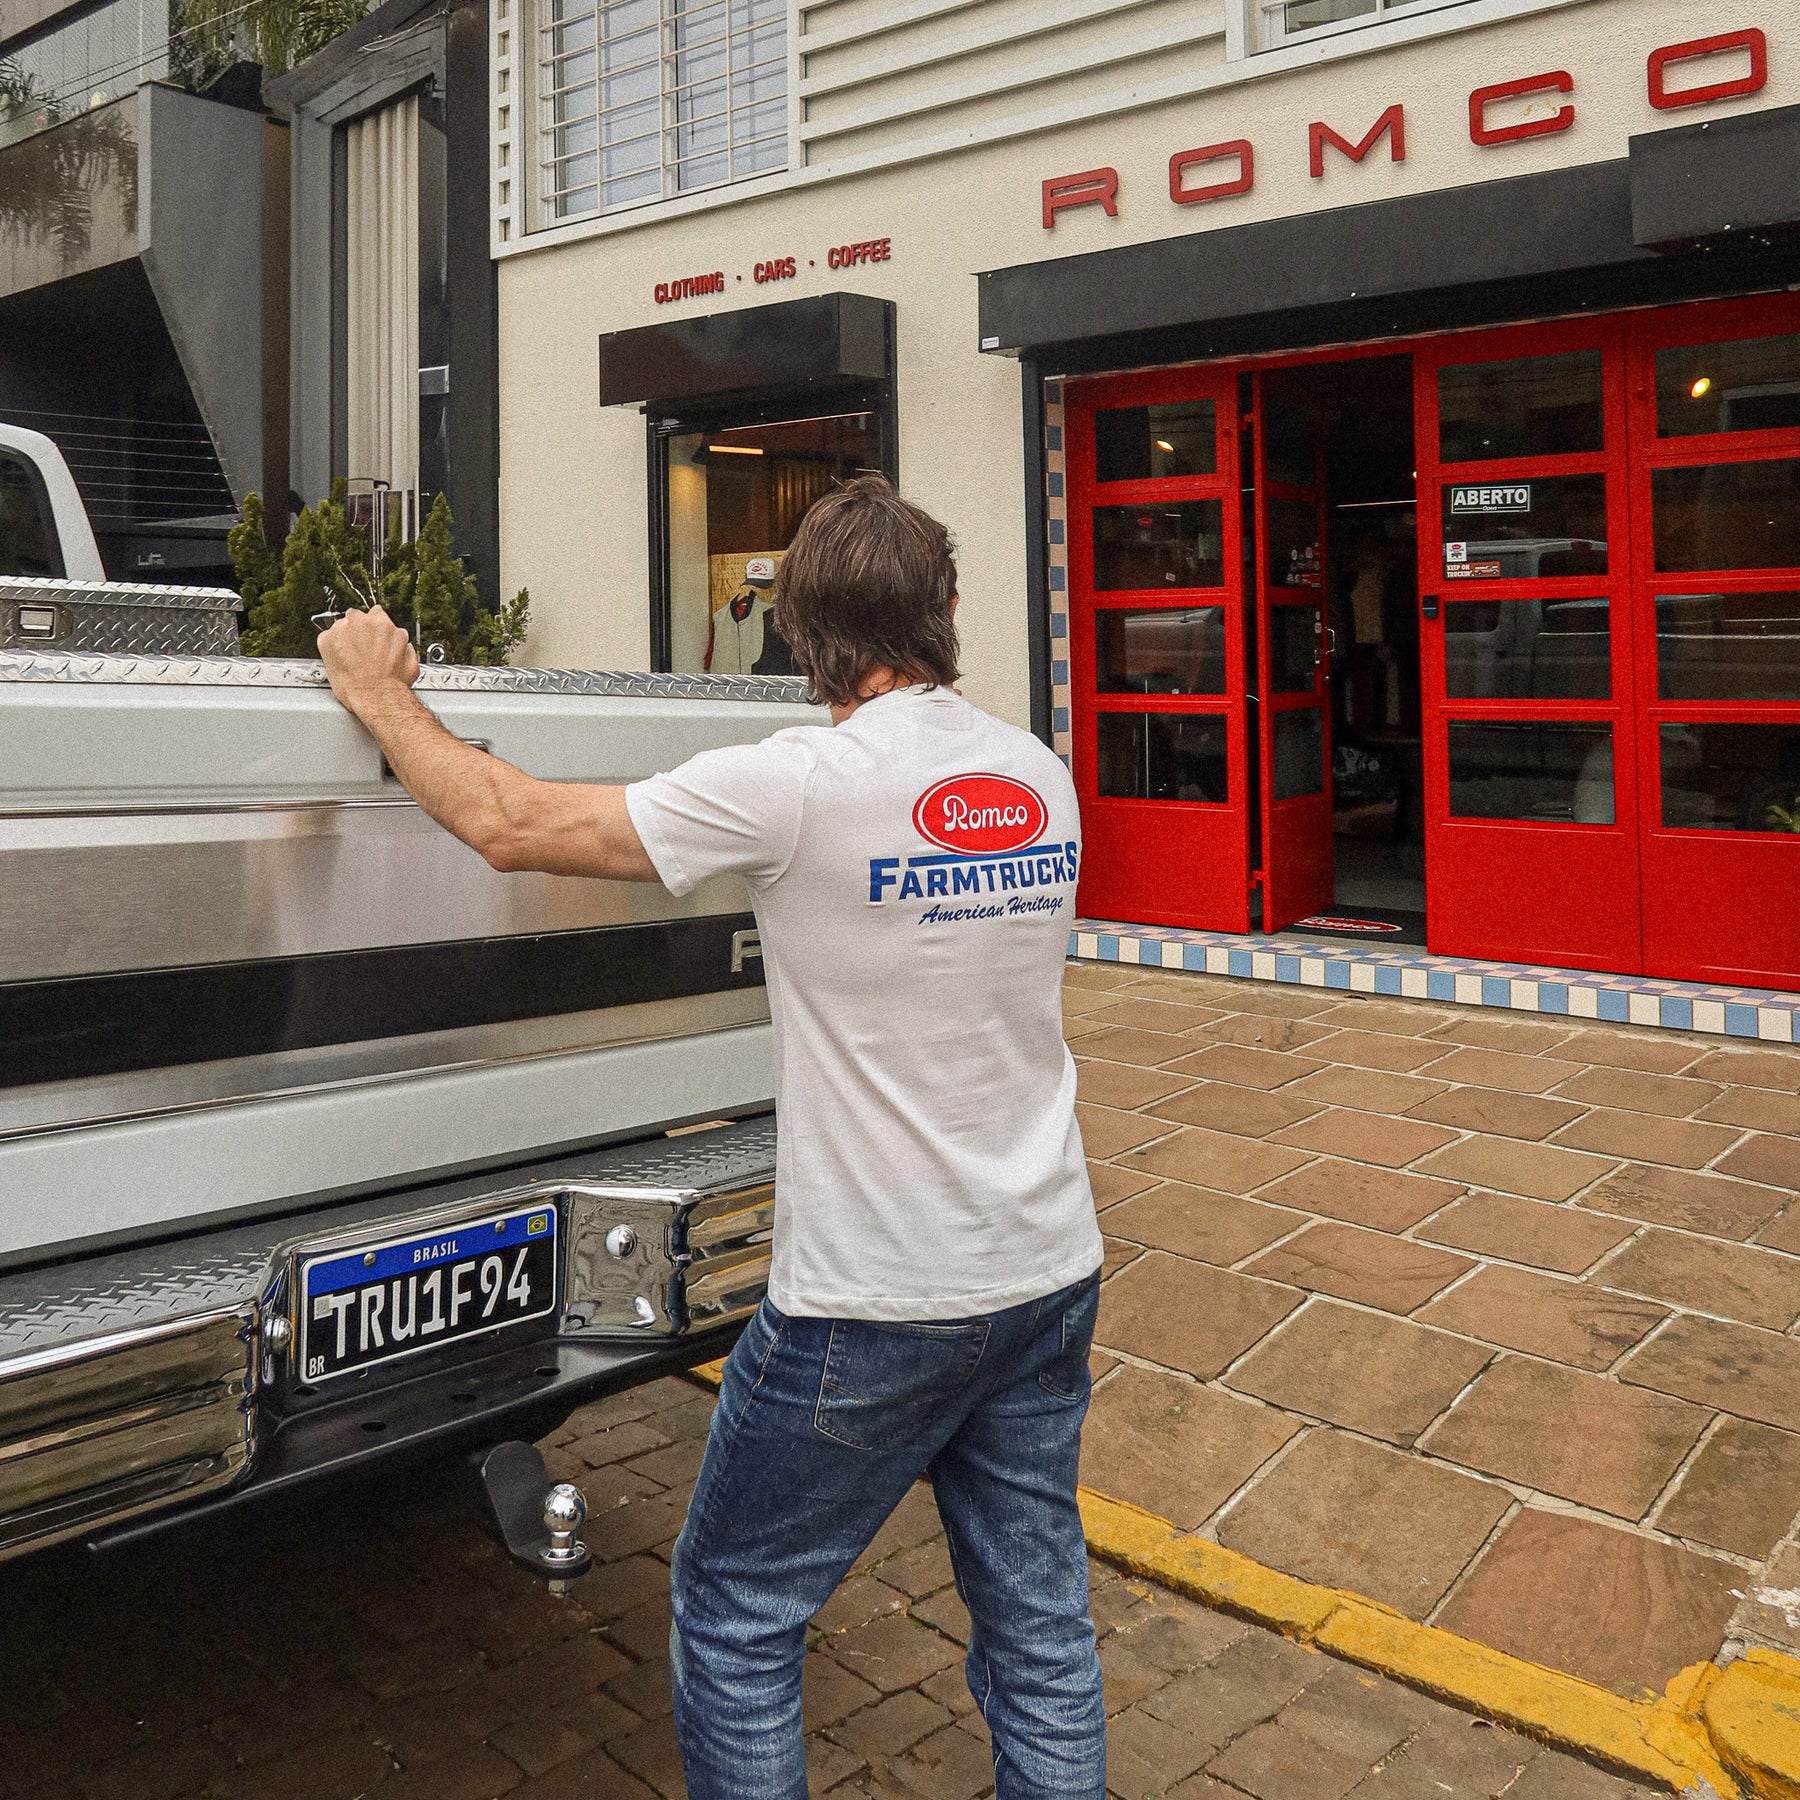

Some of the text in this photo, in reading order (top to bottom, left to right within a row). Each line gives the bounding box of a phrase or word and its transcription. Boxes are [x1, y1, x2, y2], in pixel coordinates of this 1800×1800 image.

[1042, 28, 1767, 229] ROMCO
[654, 237, 891, 303] CLOTHING CARS COFFEE
[1454, 488, 1528, 506] ABERTO
[1482, 505, 1498, 513] Open
[942, 794, 1028, 832] Romco
[869, 841, 1078, 902] FARMTRUCKS
[918, 896, 1064, 925] American Heritage
[413, 1240, 459, 1264] BRASIL
[328, 1247, 532, 1359] TRU1F94
[309, 1355, 325, 1378] BR
